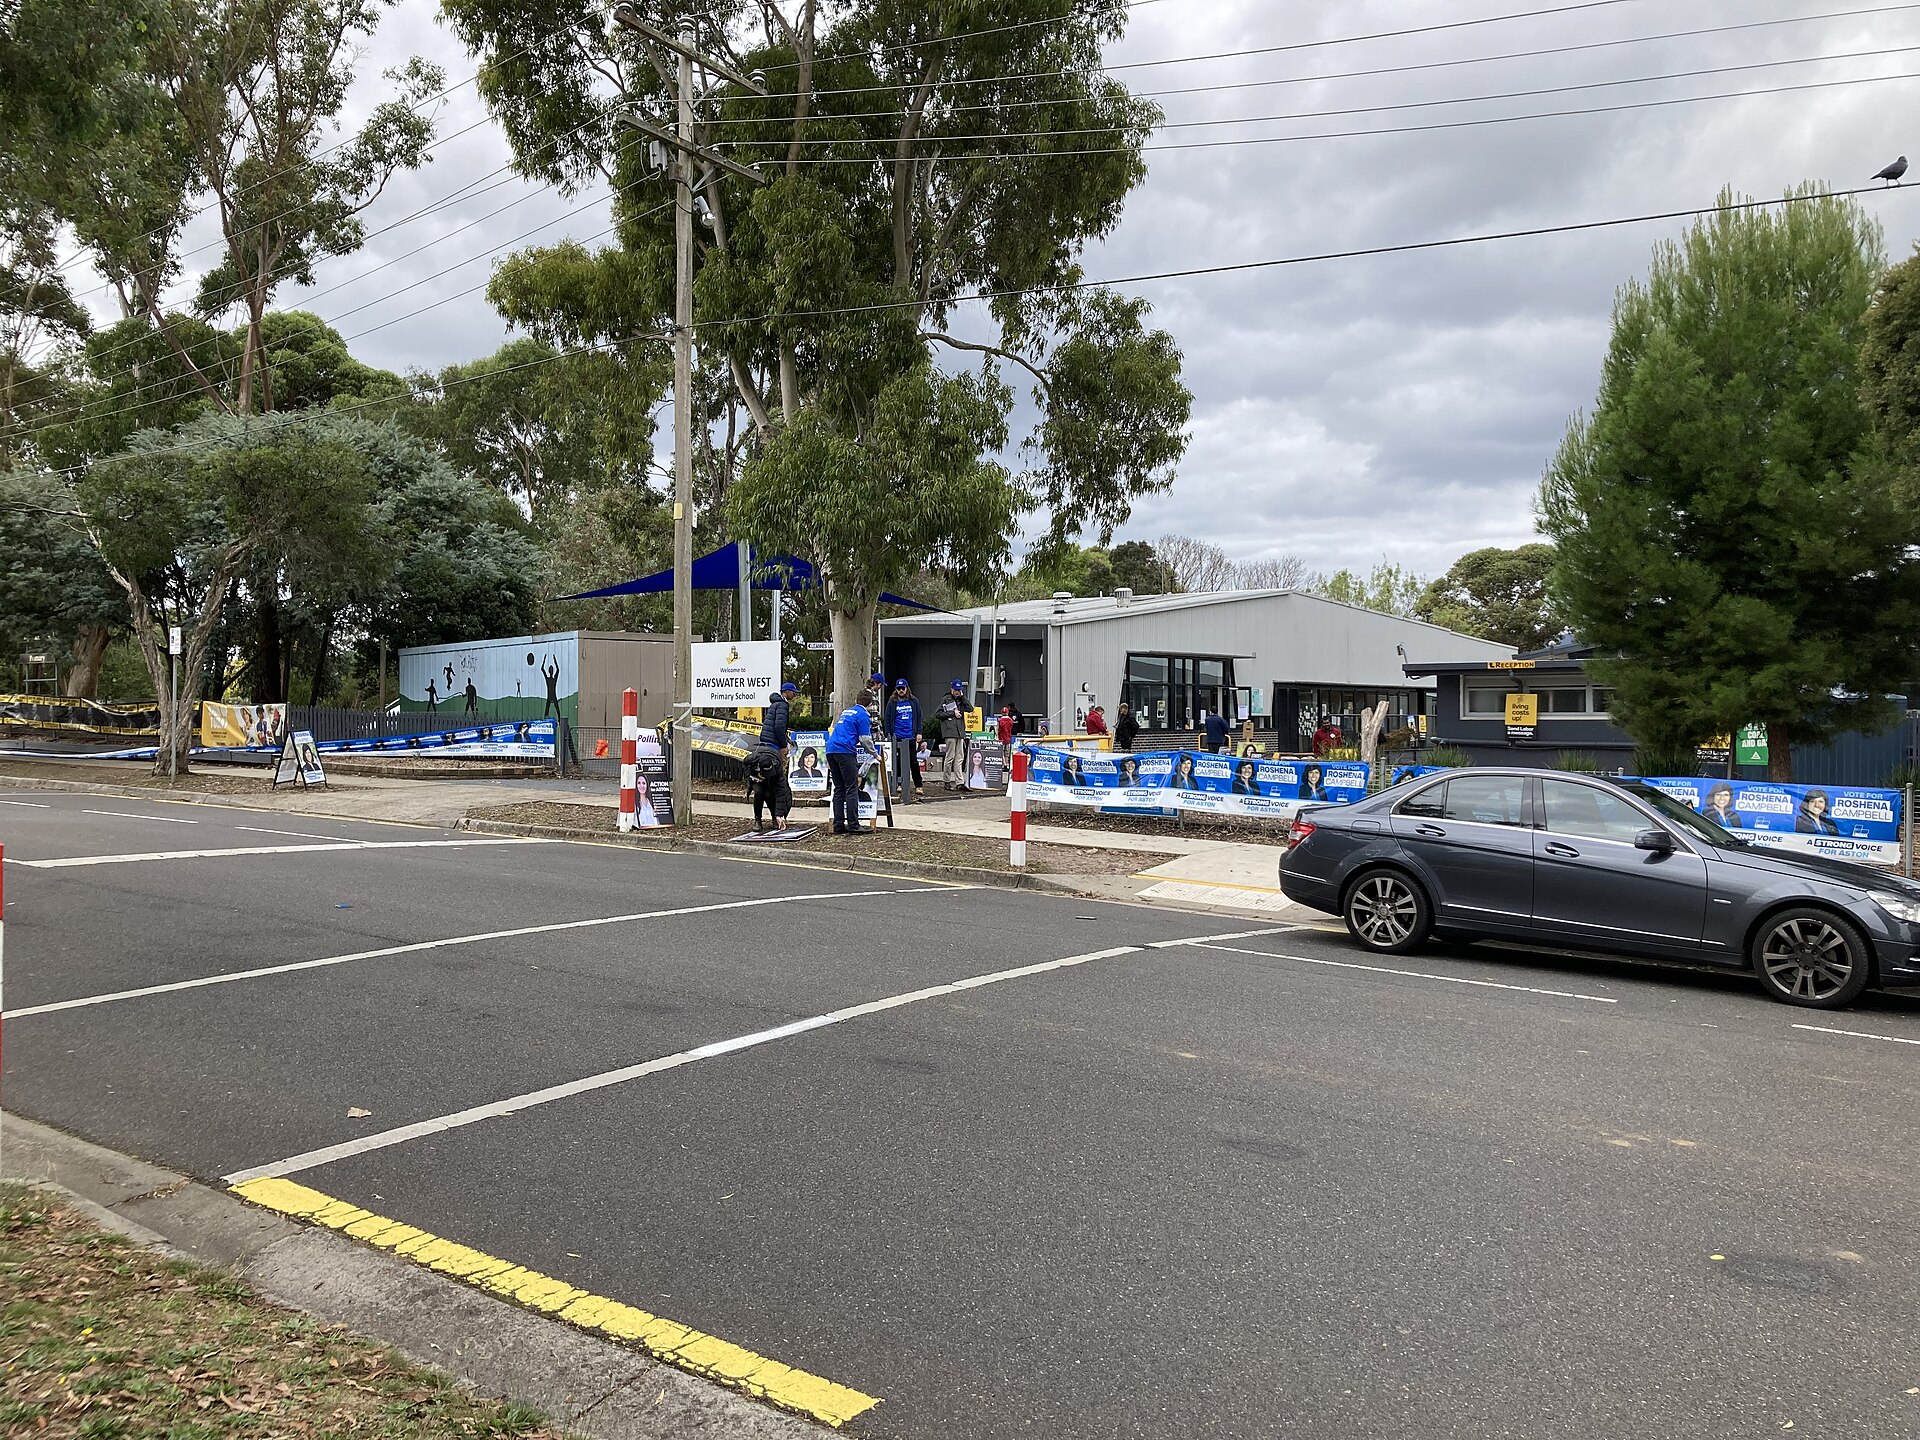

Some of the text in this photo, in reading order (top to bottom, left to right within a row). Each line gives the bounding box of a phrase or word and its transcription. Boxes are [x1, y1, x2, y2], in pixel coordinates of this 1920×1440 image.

[696, 677, 771, 688] BAYSWATER WEST
[711, 692, 755, 702] Primary School
[637, 734, 659, 744] Pollin
[1742, 739, 1755, 748] AND
[1196, 769, 1229, 778] CAMPBELL
[1260, 766, 1294, 774] ROSHENA
[1328, 770, 1362, 779] ROSHENA
[1258, 774, 1296, 783] CAMPBELL
[1326, 779, 1363, 787] CAMPBELL
[1660, 788, 1695, 796] OSHENA
[1182, 793, 1206, 801] STRONG
[1741, 793, 1788, 803] ROSHENA
[1738, 801, 1791, 813] CAMPBELL
[1837, 800, 1888, 810] ROSHENA
[1834, 808, 1891, 821] CAMPBELL
[1814, 840, 1853, 849] STRONG
[1855, 844, 1883, 852] VOICE
[1838, 850, 1869, 858] ASTON
